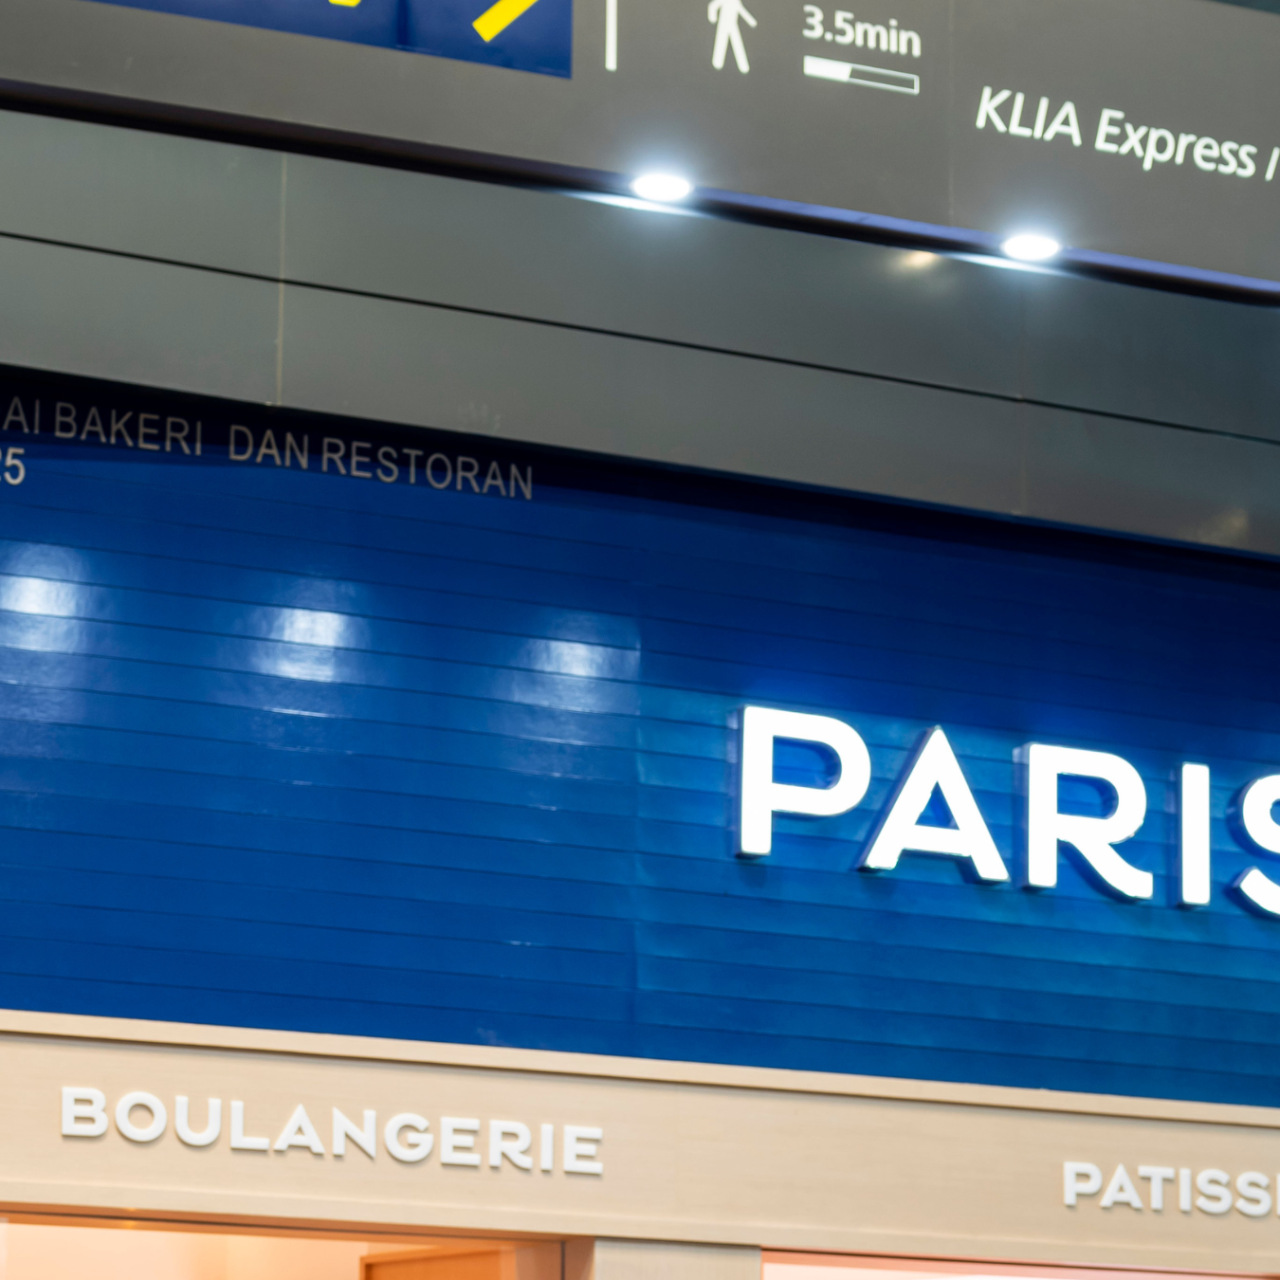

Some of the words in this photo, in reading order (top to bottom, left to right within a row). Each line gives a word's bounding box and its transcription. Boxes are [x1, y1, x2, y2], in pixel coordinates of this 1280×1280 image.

[802, 4, 922, 58] 3.5min
[976, 85, 1082, 147] KLIA
[1094, 108, 1257, 178] Express
[54, 401, 202, 456] BAKERI
[228, 425, 309, 470] DAN
[321, 436, 533, 500] RESTORAN
[61, 1085, 604, 1176] BOULANGERIE
